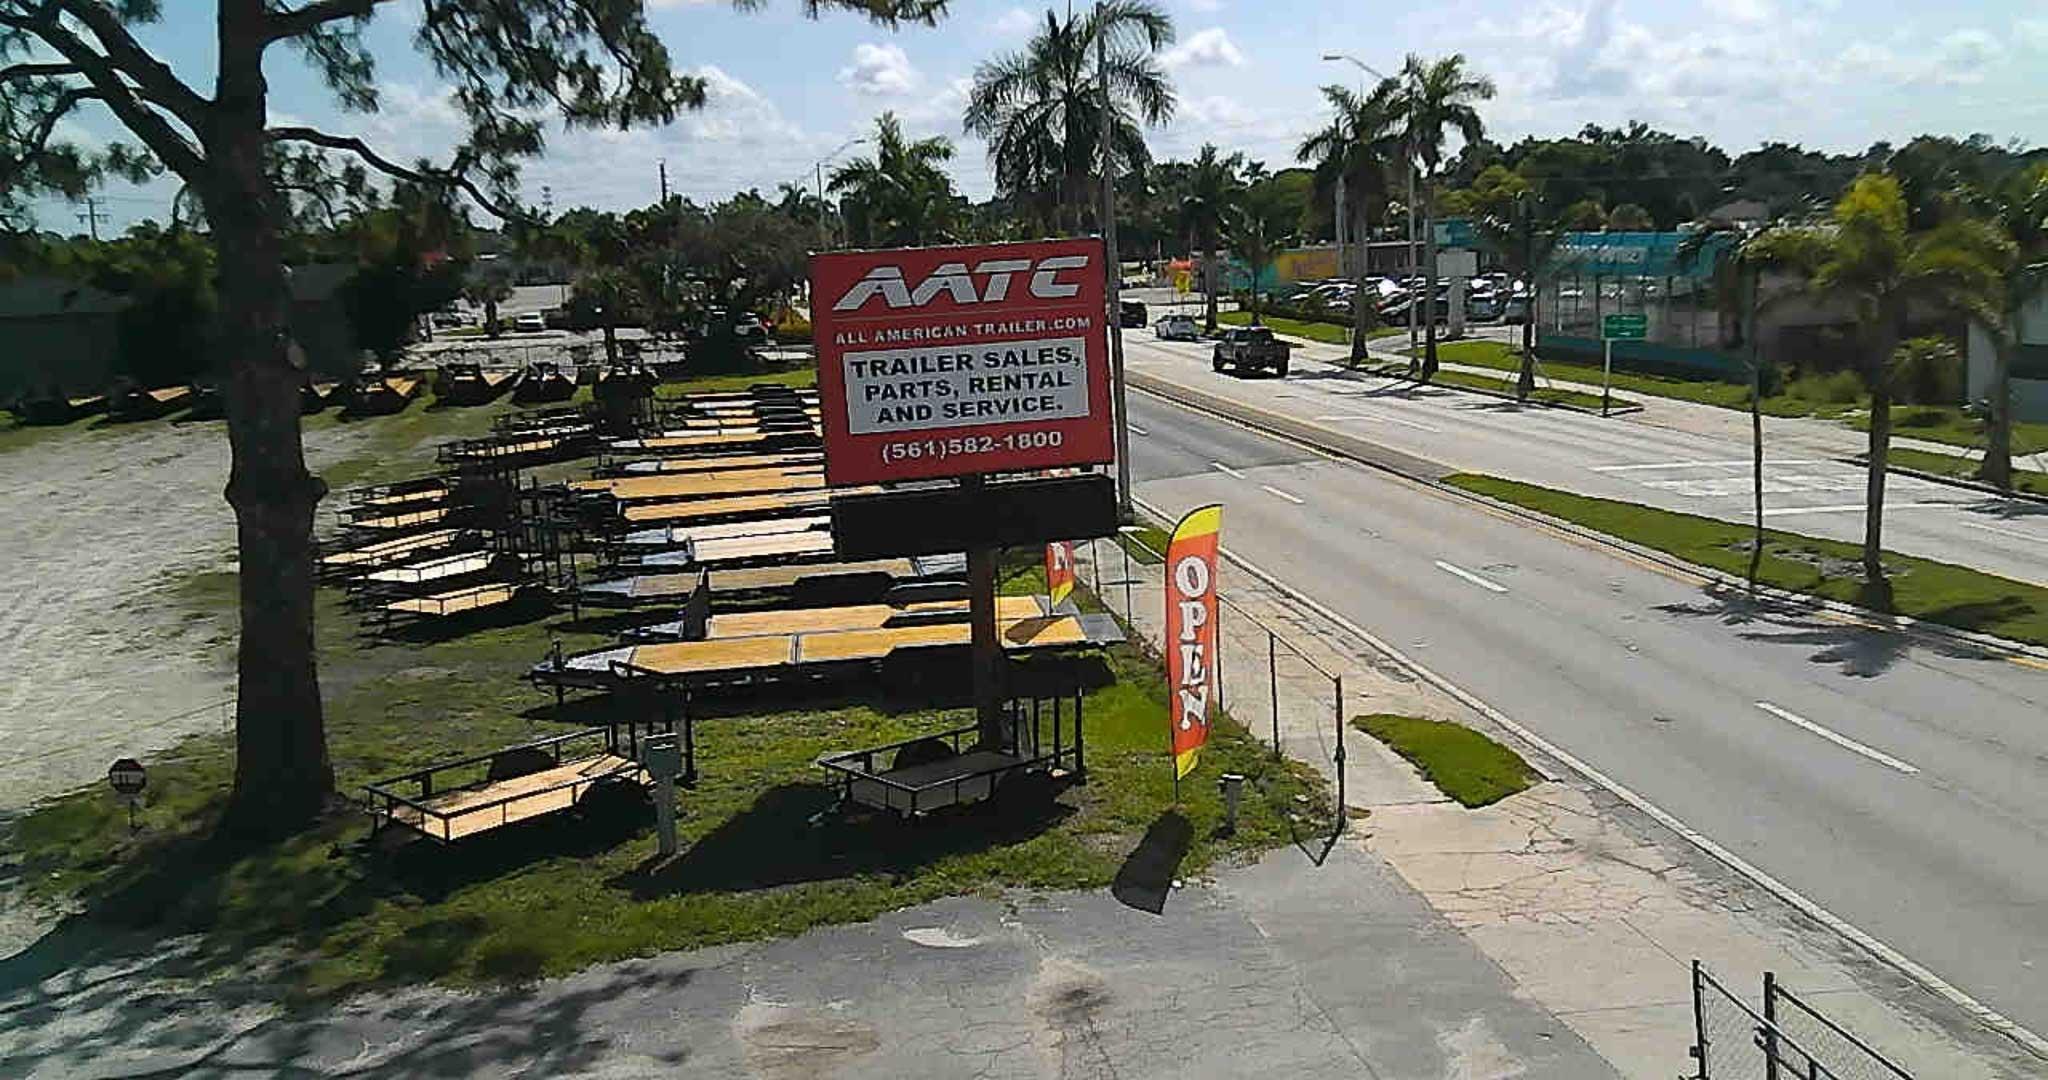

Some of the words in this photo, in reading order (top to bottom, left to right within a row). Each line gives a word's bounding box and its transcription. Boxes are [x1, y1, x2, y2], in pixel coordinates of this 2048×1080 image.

[832, 255, 1089, 311] AATC
[836, 331, 867, 345] ALL
[874, 325, 967, 343] AMERICAN
[974, 317, 1091, 335] TRAILER.COM
[851, 354, 974, 379] TRAILER
[983, 346, 1081, 369] SALES,
[865, 379, 960, 402] PARTS,
[969, 371, 1072, 394] RENTAL
[876, 404, 932, 424] AND
[943, 395, 1064, 419] SERVICE.
[882, 431, 1063, 463] (561)582-1800
[1175, 555, 1209, 731] OPEN
